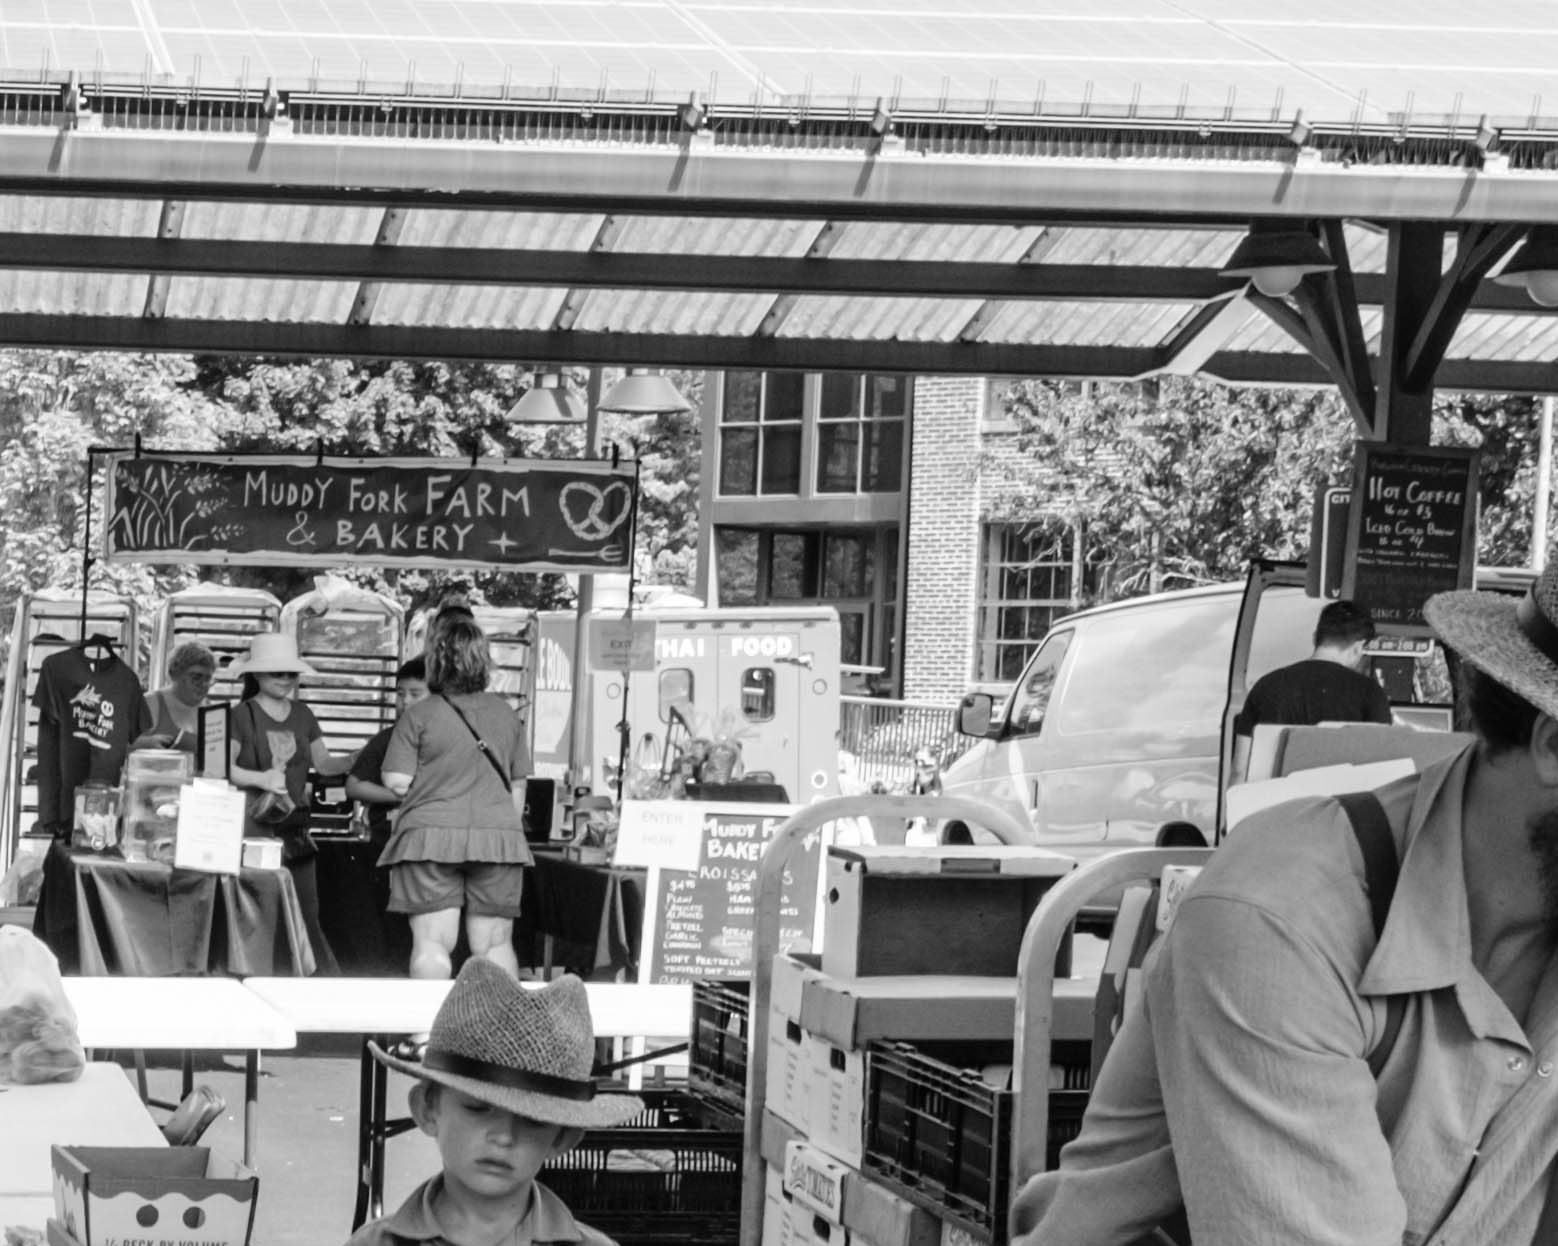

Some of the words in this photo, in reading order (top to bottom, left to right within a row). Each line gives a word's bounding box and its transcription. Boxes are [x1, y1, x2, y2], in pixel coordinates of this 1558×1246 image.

[243, 470, 333, 510] MUDDY
[348, 476, 409, 515] FORK
[425, 474, 531, 519] FARM
[286, 512, 317, 546] &
[336, 518, 475, 553] BAKERY
[731, 635, 793, 657] FOOD
[688, 866, 794, 885] ROISSAS
